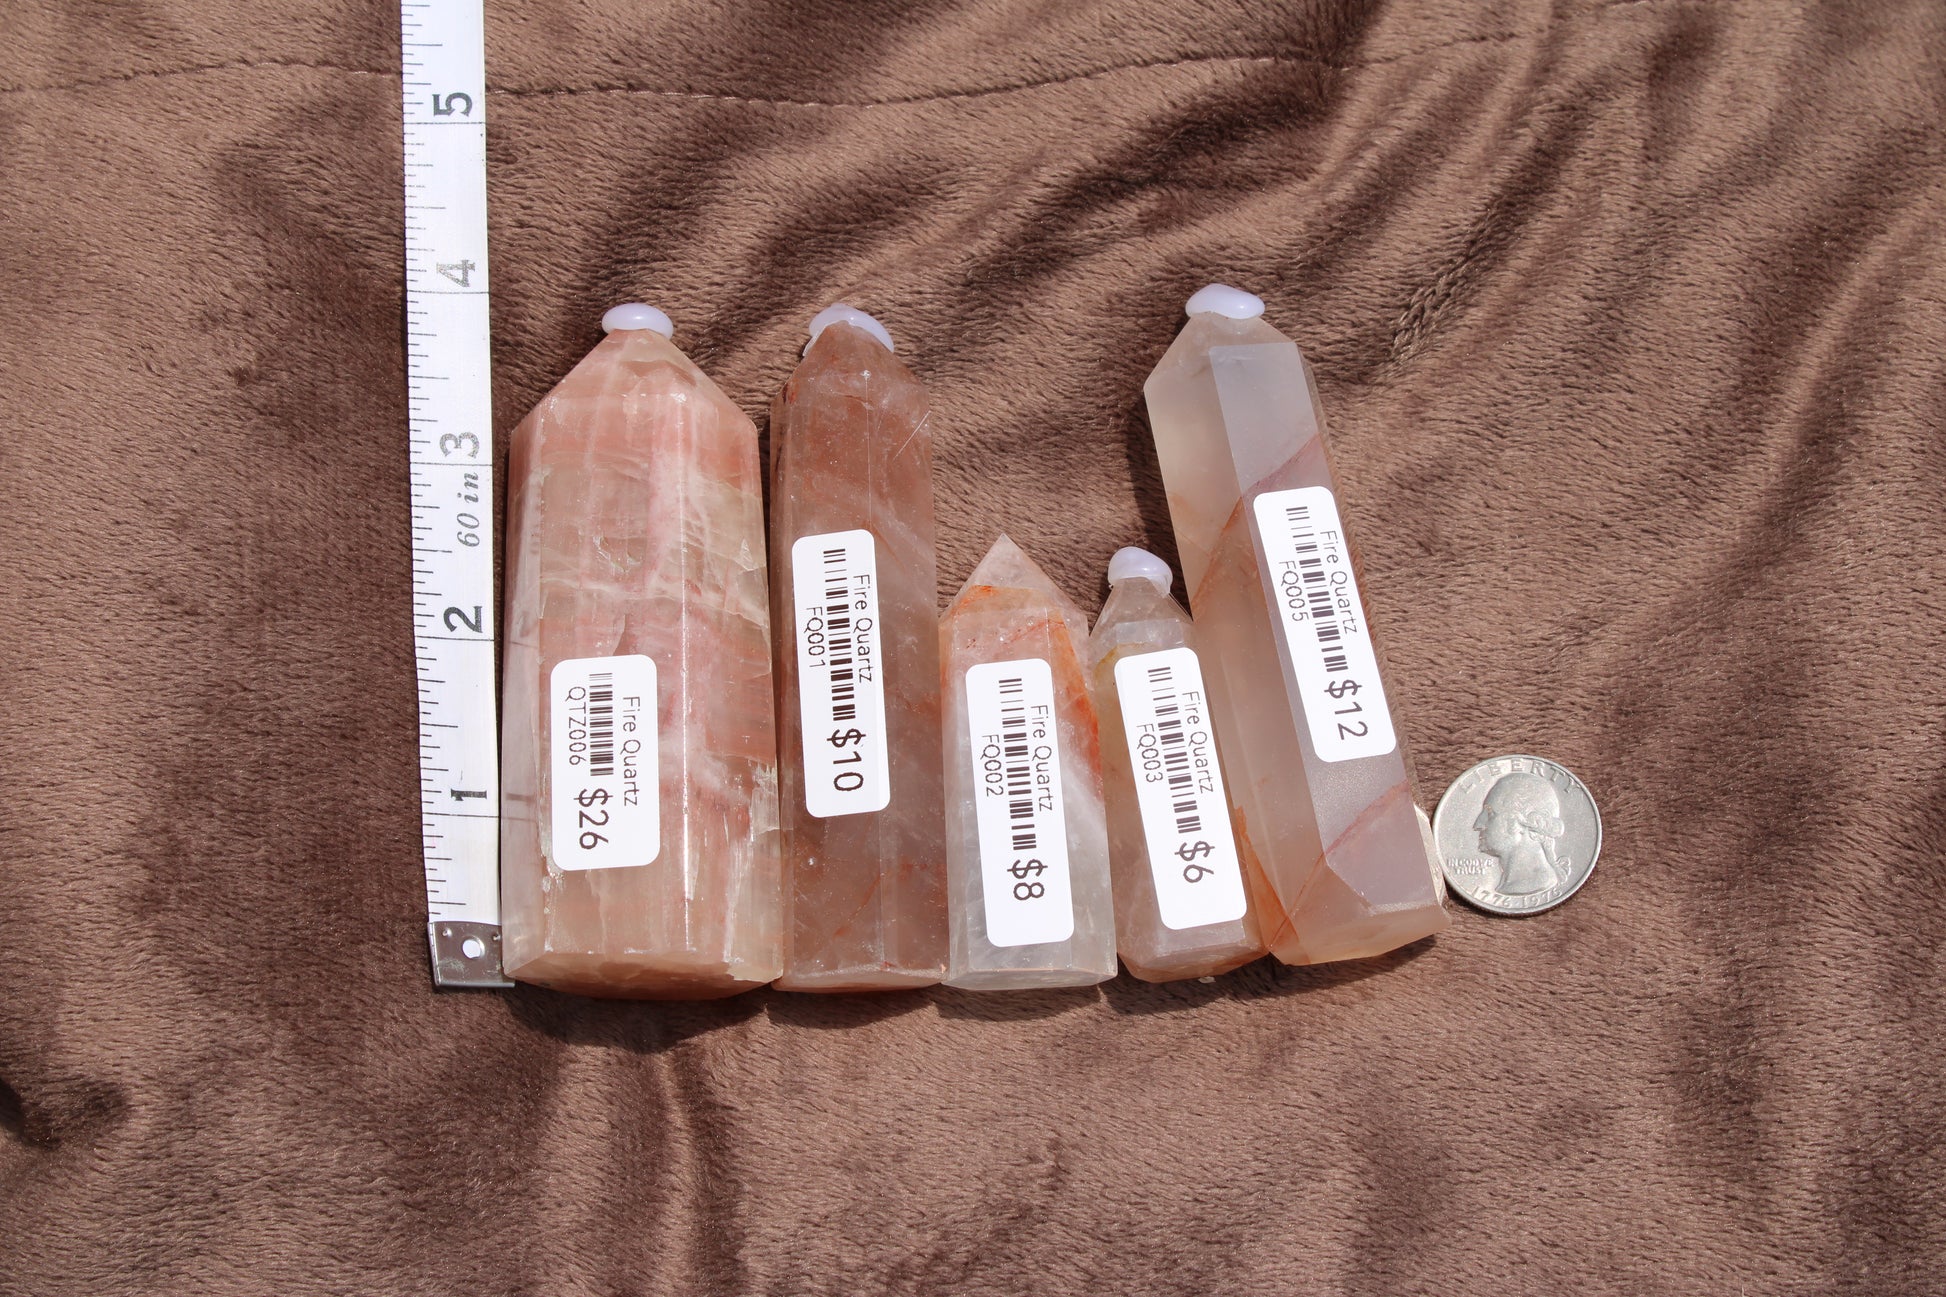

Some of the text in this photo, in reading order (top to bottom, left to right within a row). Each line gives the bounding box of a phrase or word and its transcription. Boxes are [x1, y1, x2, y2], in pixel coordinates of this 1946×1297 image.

[432, 91, 473, 118] 5
[436, 258, 476, 288] 4
[439, 431, 480, 459] 3
[456, 472, 480, 547] 60 in
[1278, 560, 1309, 622] FQ005
[1320, 530, 1357, 634] Fire Quartz
[443, 605, 483, 634] 2
[803, 606, 826, 667] FQ001
[853, 574, 873, 683] Fire Quartz
[565, 686, 587, 765] QTZ006
[1324, 679, 1368, 740] $12
[620, 696, 641, 806] Fire Quartz
[826, 728, 867, 791] $10
[980, 734, 1003, 798] FQ002
[1030, 705, 1053, 812] Fire Quartz
[1136, 723, 1163, 783] FQ003
[1182, 691, 1214, 793] Fire Quartz
[450, 788, 487, 803] 1
[1459, 758, 1580, 793] LIBERTY
[573, 788, 614, 850] $26
[1006, 858, 1048, 901] $8
[1174, 840, 1216, 884] $6
